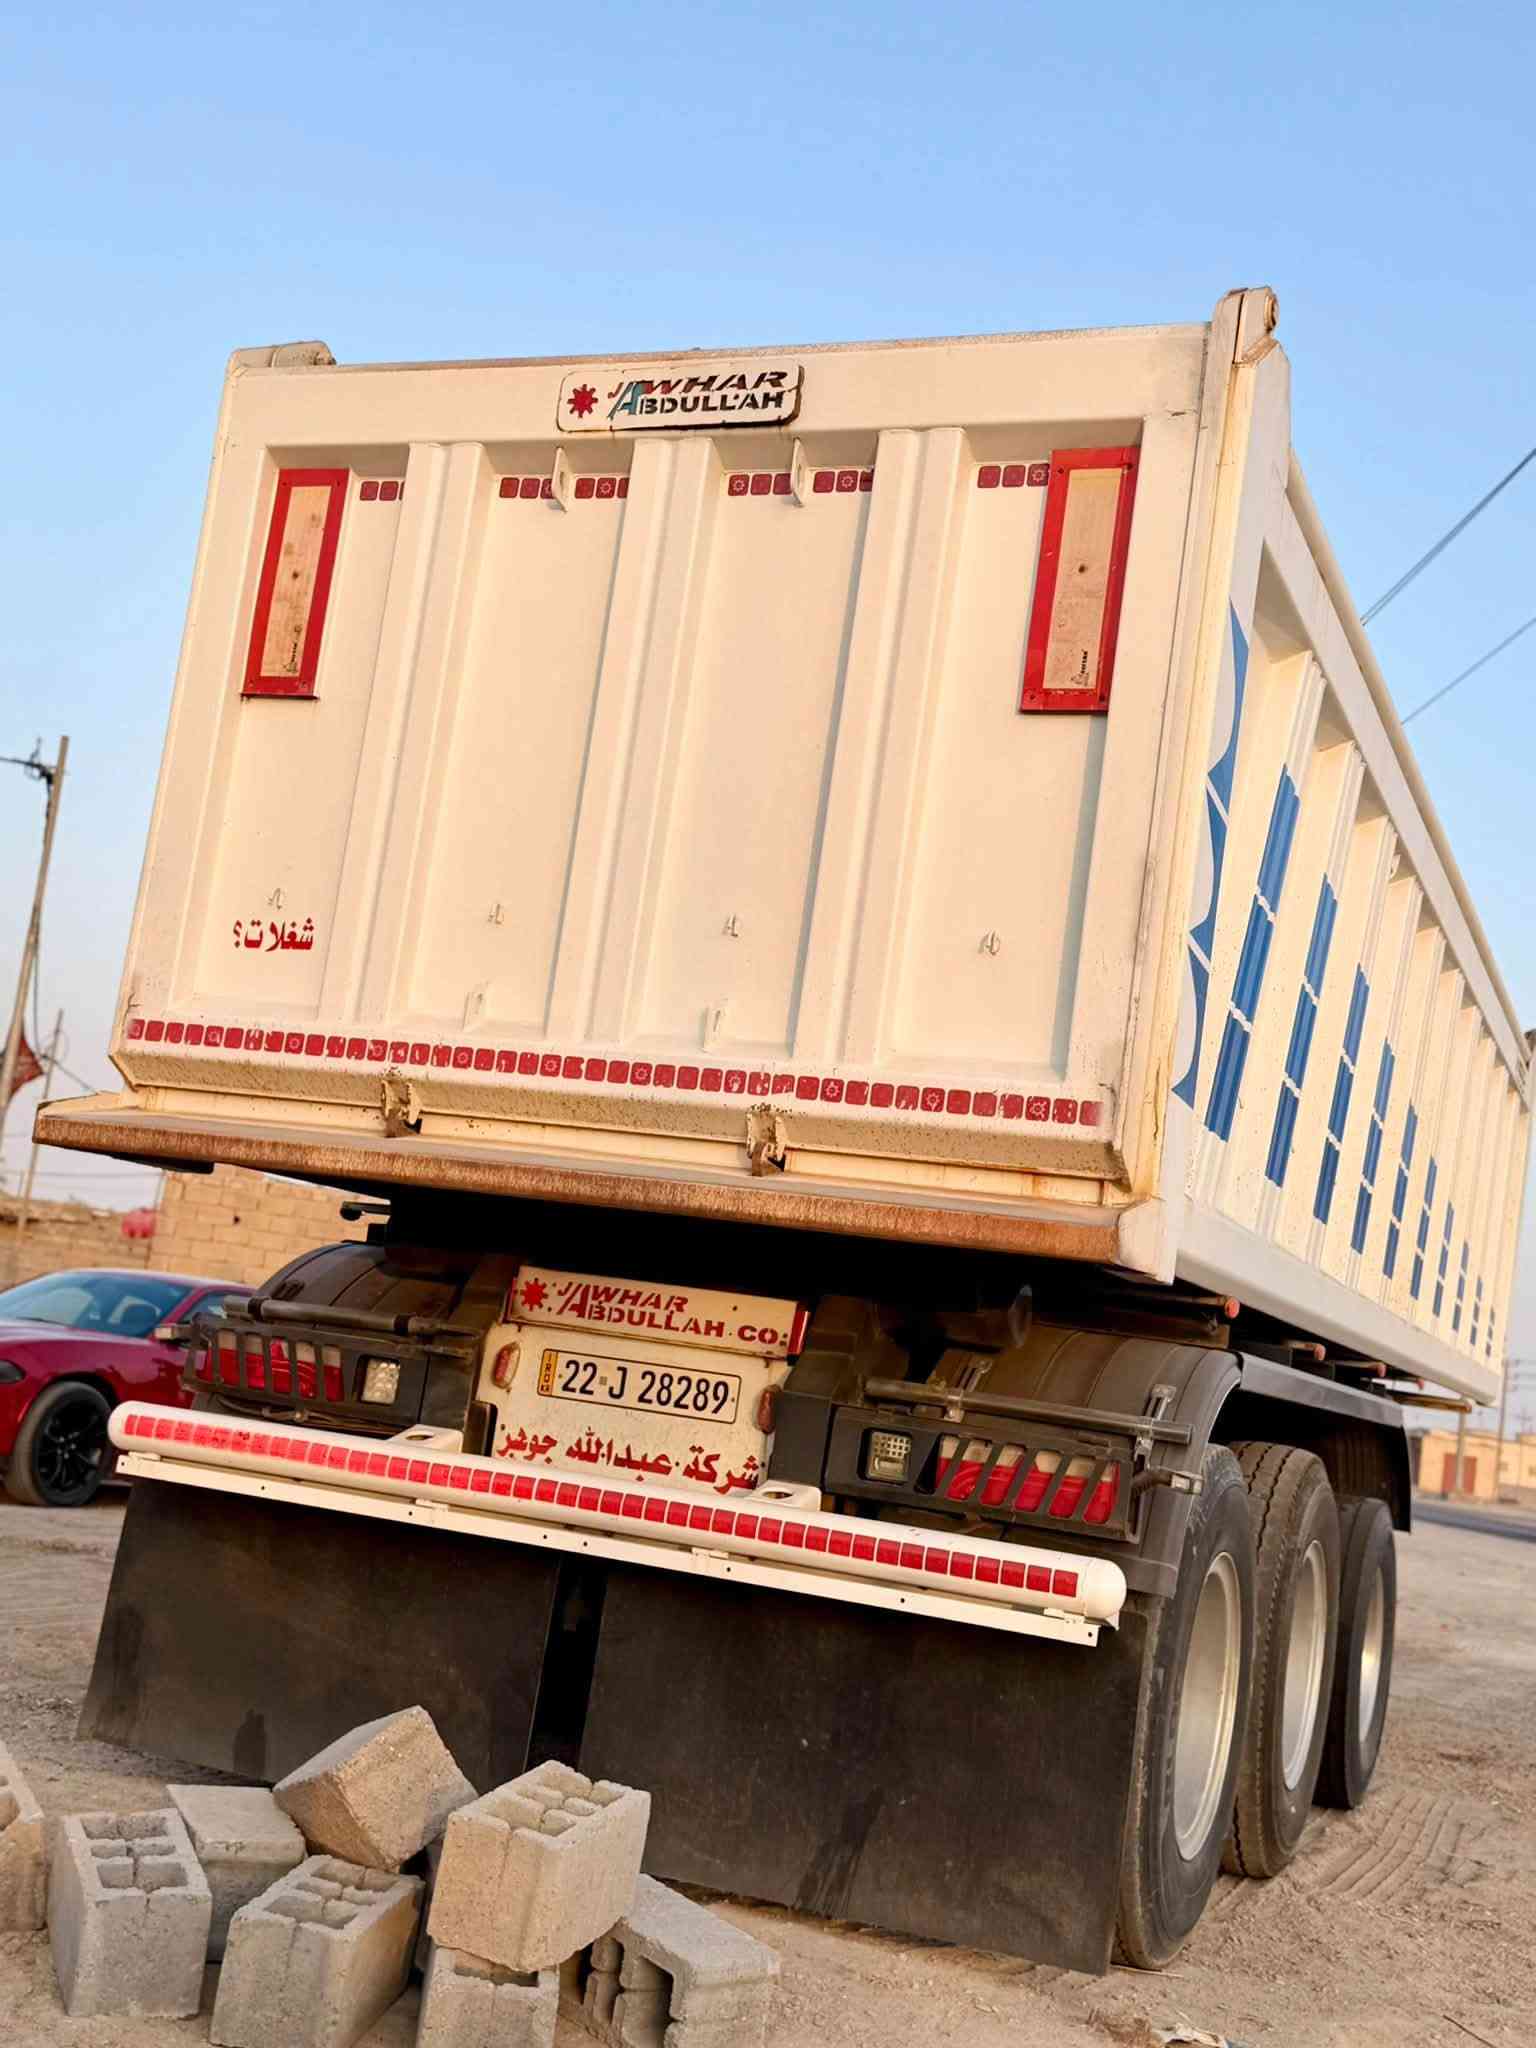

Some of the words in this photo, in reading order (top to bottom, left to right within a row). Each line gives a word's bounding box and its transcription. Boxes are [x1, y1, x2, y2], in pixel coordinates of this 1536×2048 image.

[562, 1360, 597, 1395] 22
[608, 1366, 628, 1399] J
[637, 1370, 729, 1414] 28289
[496, 1427, 557, 1465] جوهر
[682, 1444, 759, 1494] شركة
